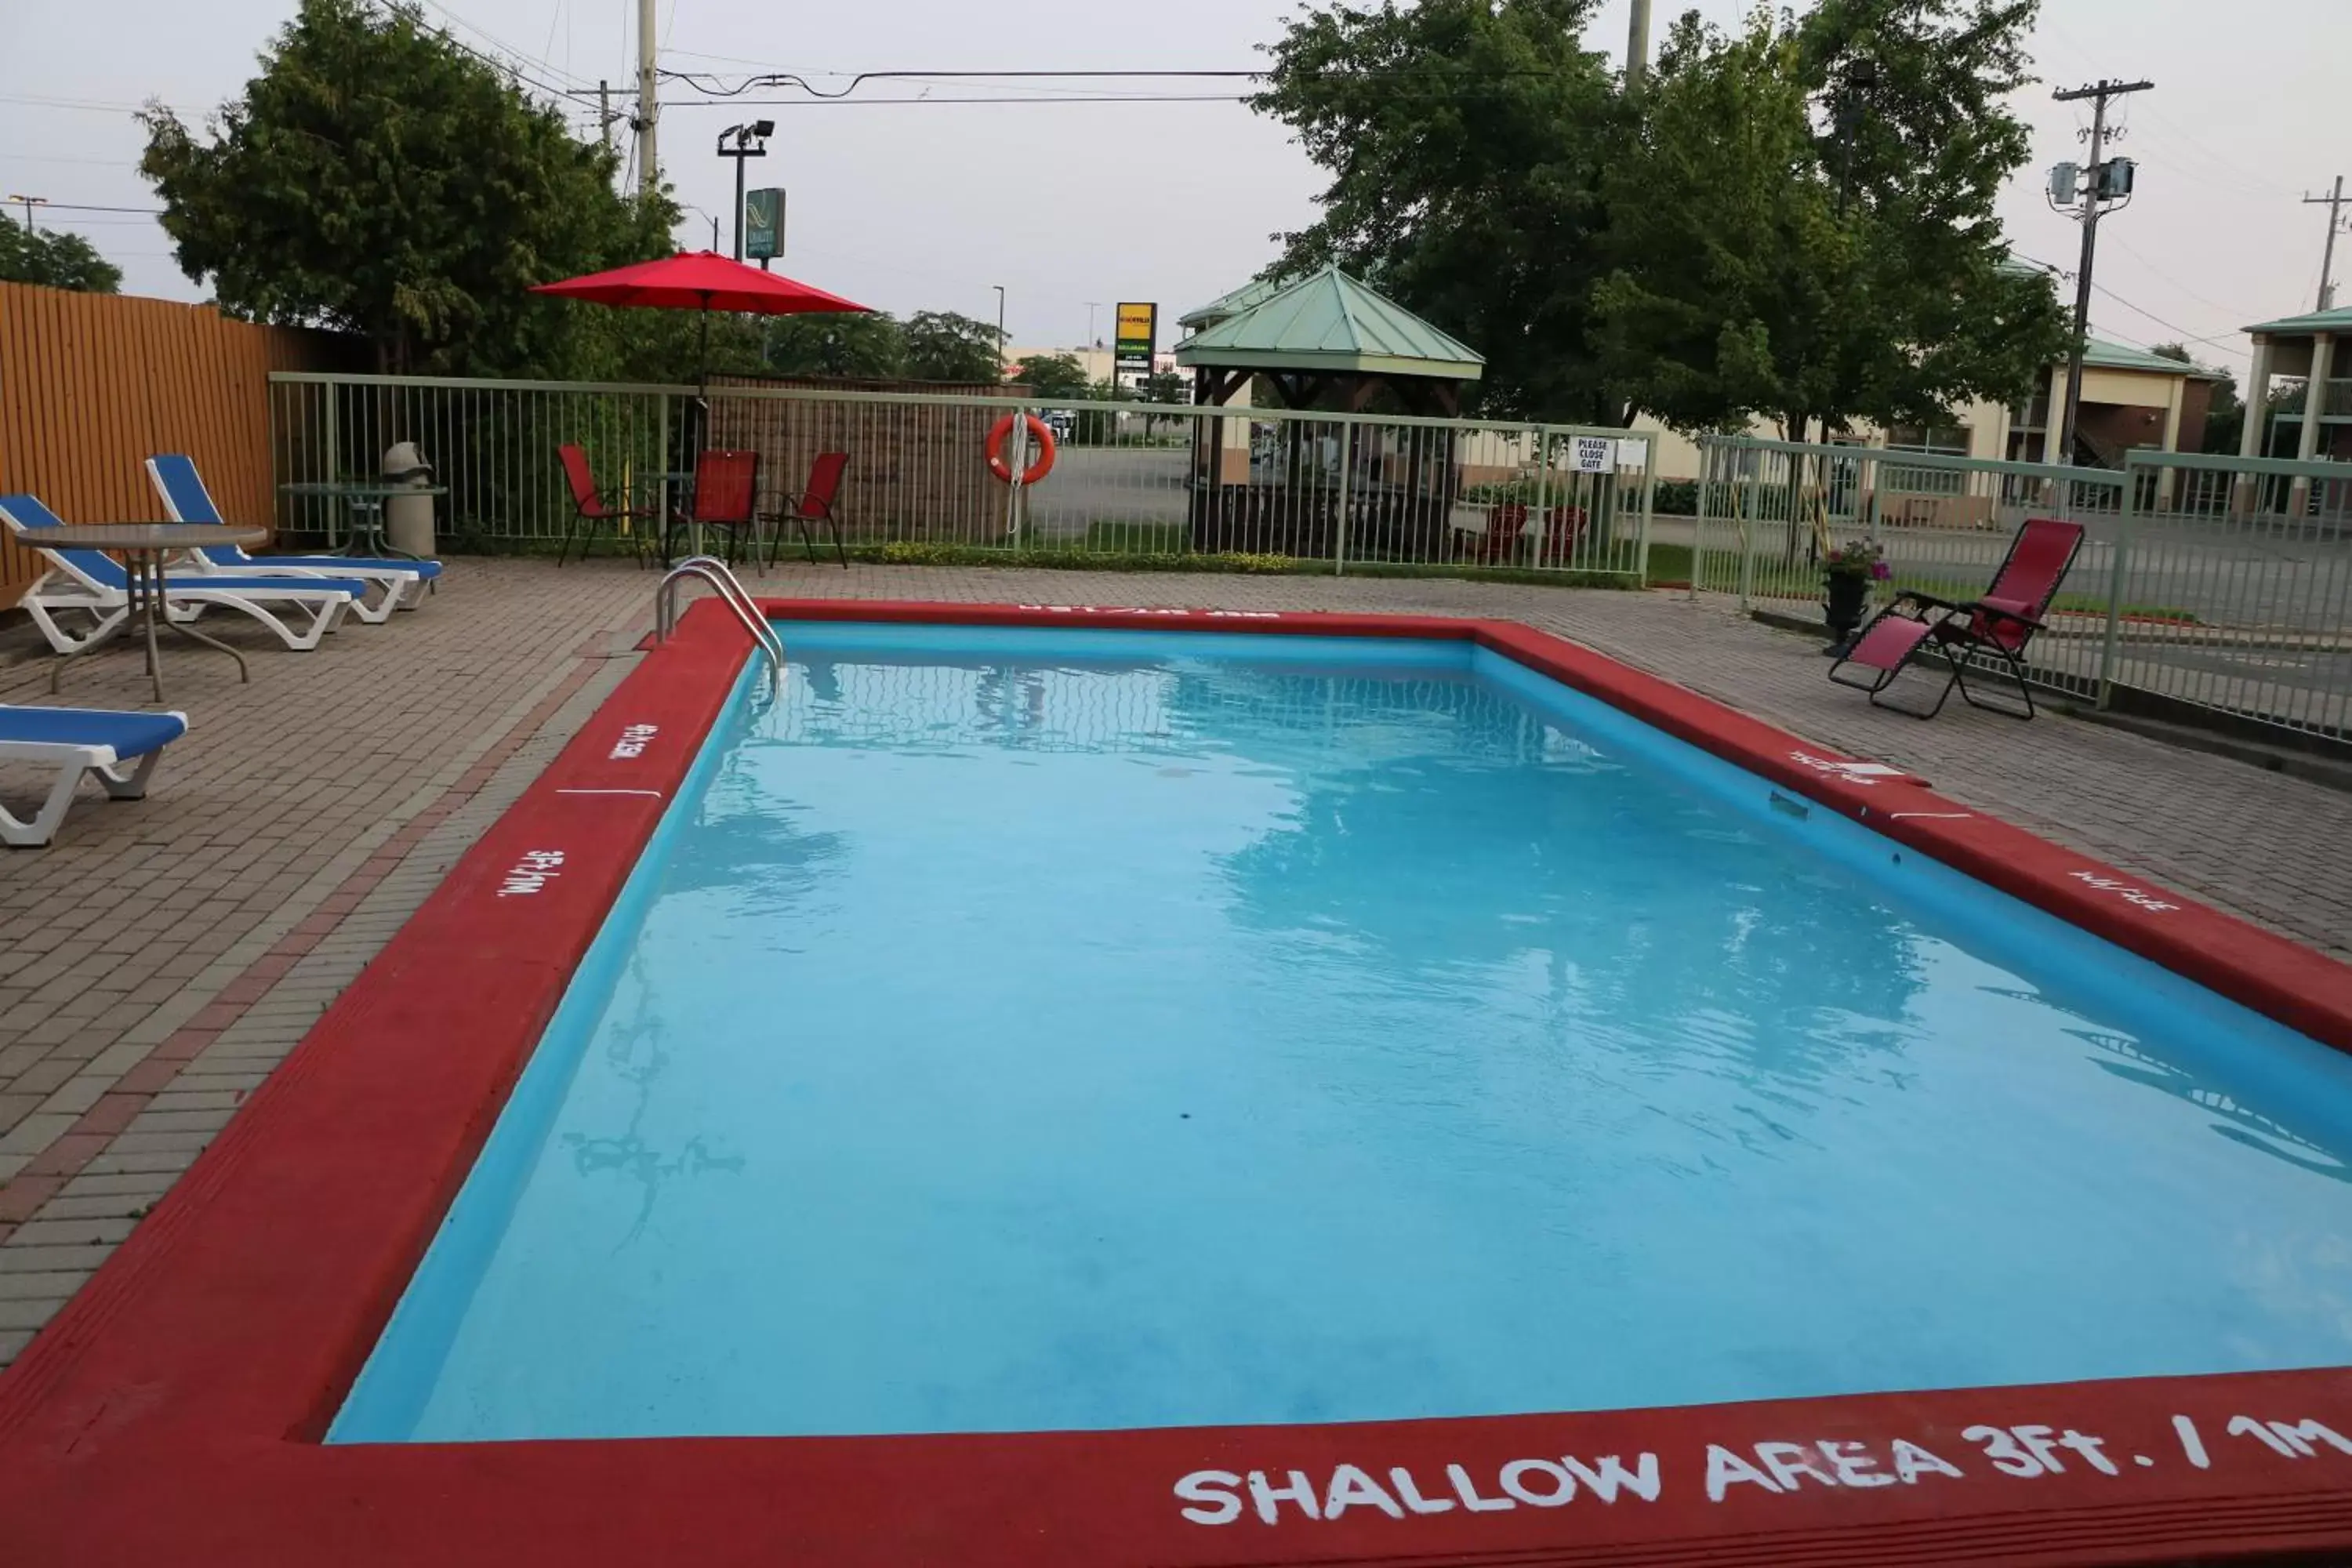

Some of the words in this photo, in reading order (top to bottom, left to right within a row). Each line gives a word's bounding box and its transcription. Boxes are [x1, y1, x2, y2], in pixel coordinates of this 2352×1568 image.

[1578, 439, 1607, 450] PLEASE
[1580, 449, 1604, 459] CLOSE
[1581, 459, 1602, 469] GATE
[1174, 1451, 1661, 1525] SHALLOW
[1706, 1438, 1965, 1503] AREA
